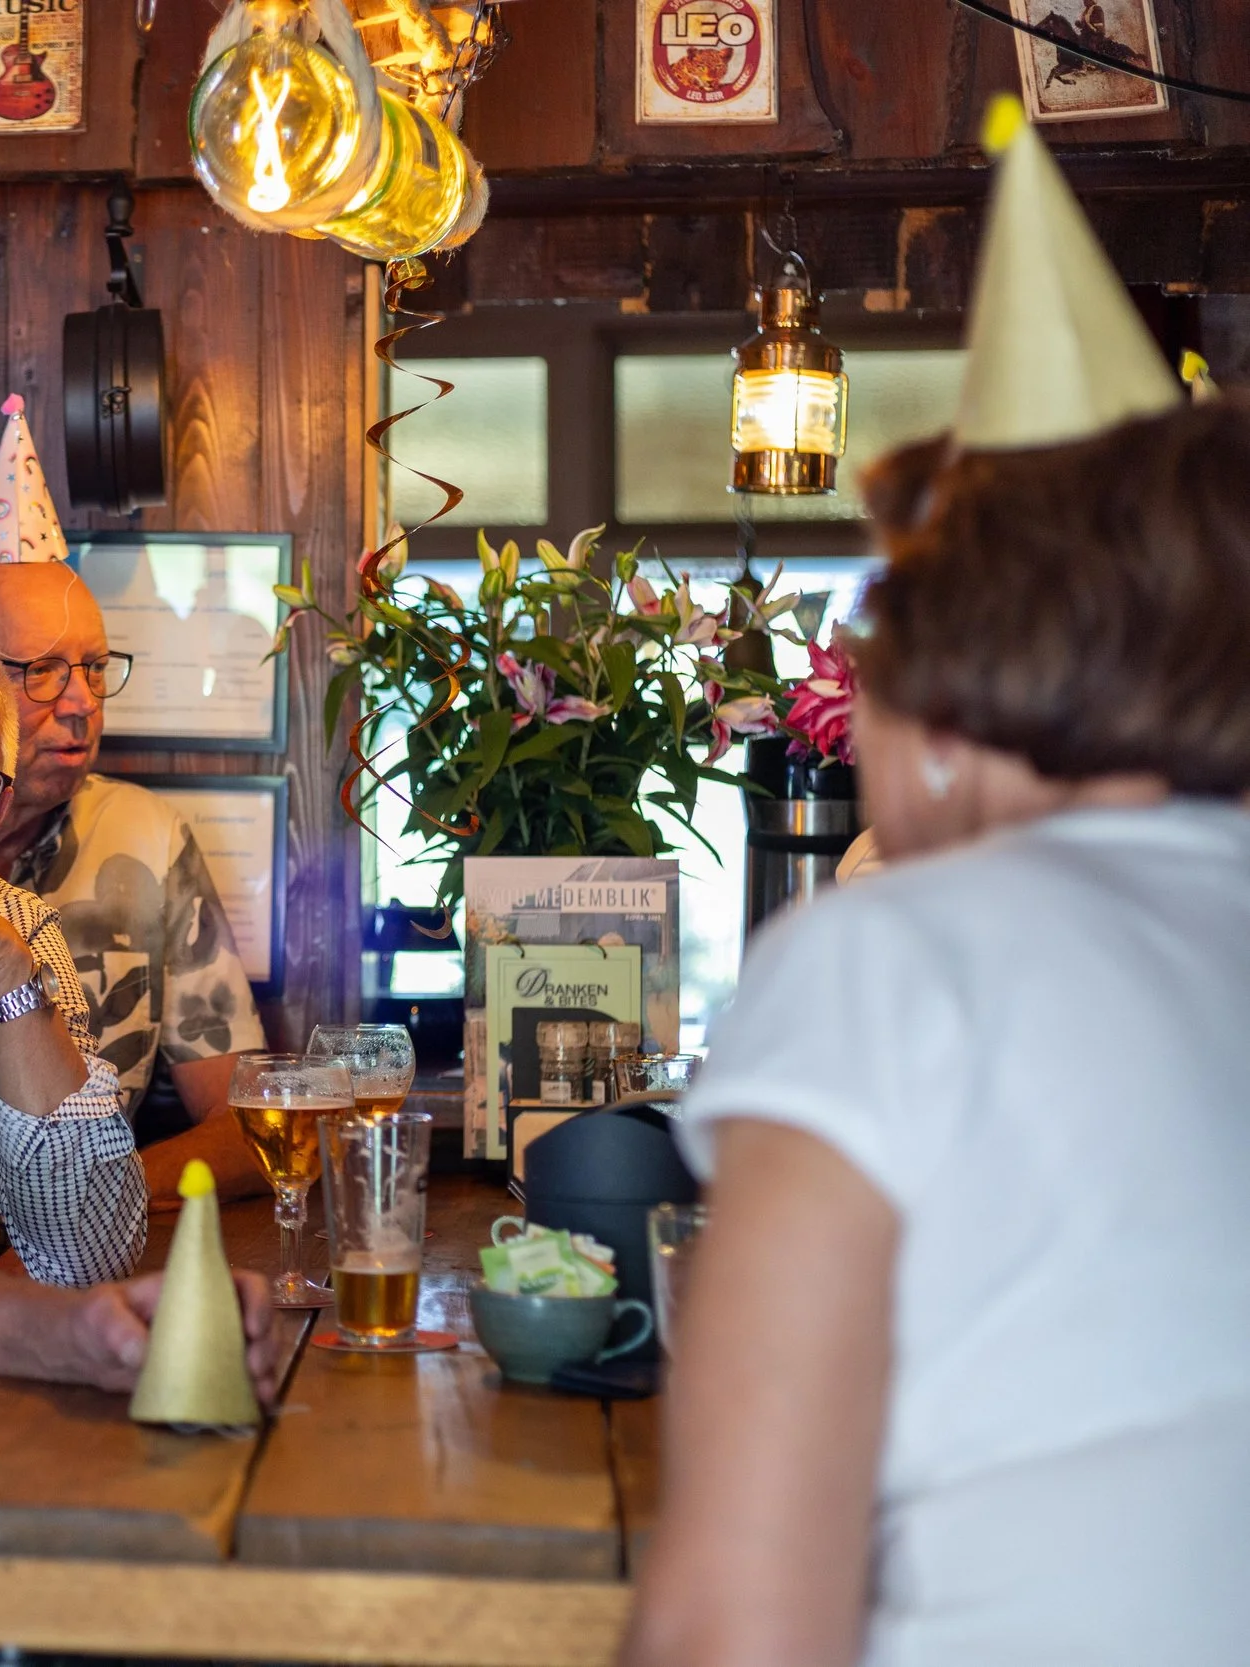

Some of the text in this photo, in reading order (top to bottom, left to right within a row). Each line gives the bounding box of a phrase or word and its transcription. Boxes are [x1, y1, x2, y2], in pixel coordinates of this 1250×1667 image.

[660, 12, 755, 46] LEO
[544, 995, 598, 1007] & BITES
